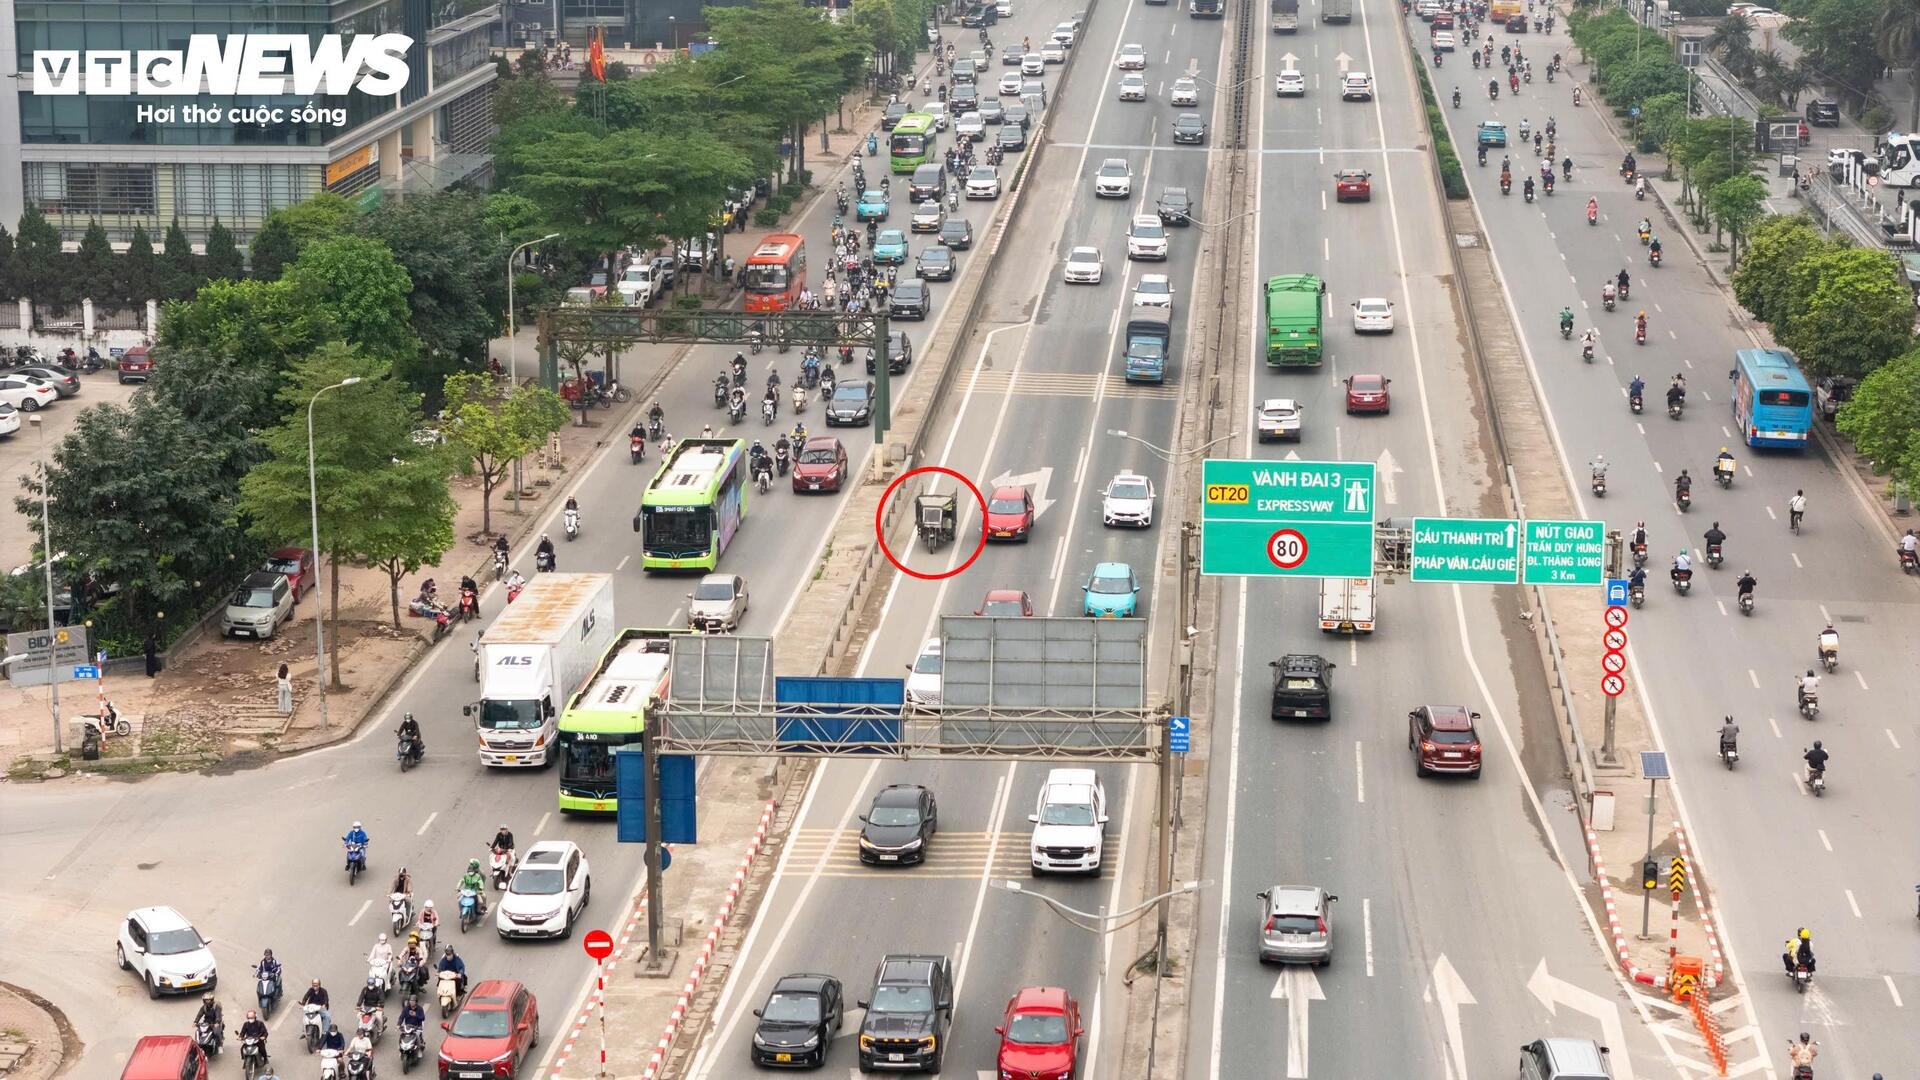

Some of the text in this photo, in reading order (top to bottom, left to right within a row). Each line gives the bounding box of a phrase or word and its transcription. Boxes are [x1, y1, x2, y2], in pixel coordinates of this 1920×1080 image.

[1252, 469, 1341, 488] VÀNH ĐAI 3
[1257, 500, 1335, 513] EXPRESSWAY
[1536, 523, 1594, 539] NÚT GIAO
[1442, 532, 1483, 546] THANH
[1485, 532, 1504, 546] TRÌ
[1277, 540, 1299, 557] 80
[1555, 542, 1573, 553] DUY
[1414, 554, 1445, 569] PHÁP
[1577, 557, 1602, 567] LONG
[1551, 572, 1576, 580] 3 Km
[581, 608, 595, 642] ALS
[28, 636, 53, 649] BID
[496, 656, 533, 666] ALS
